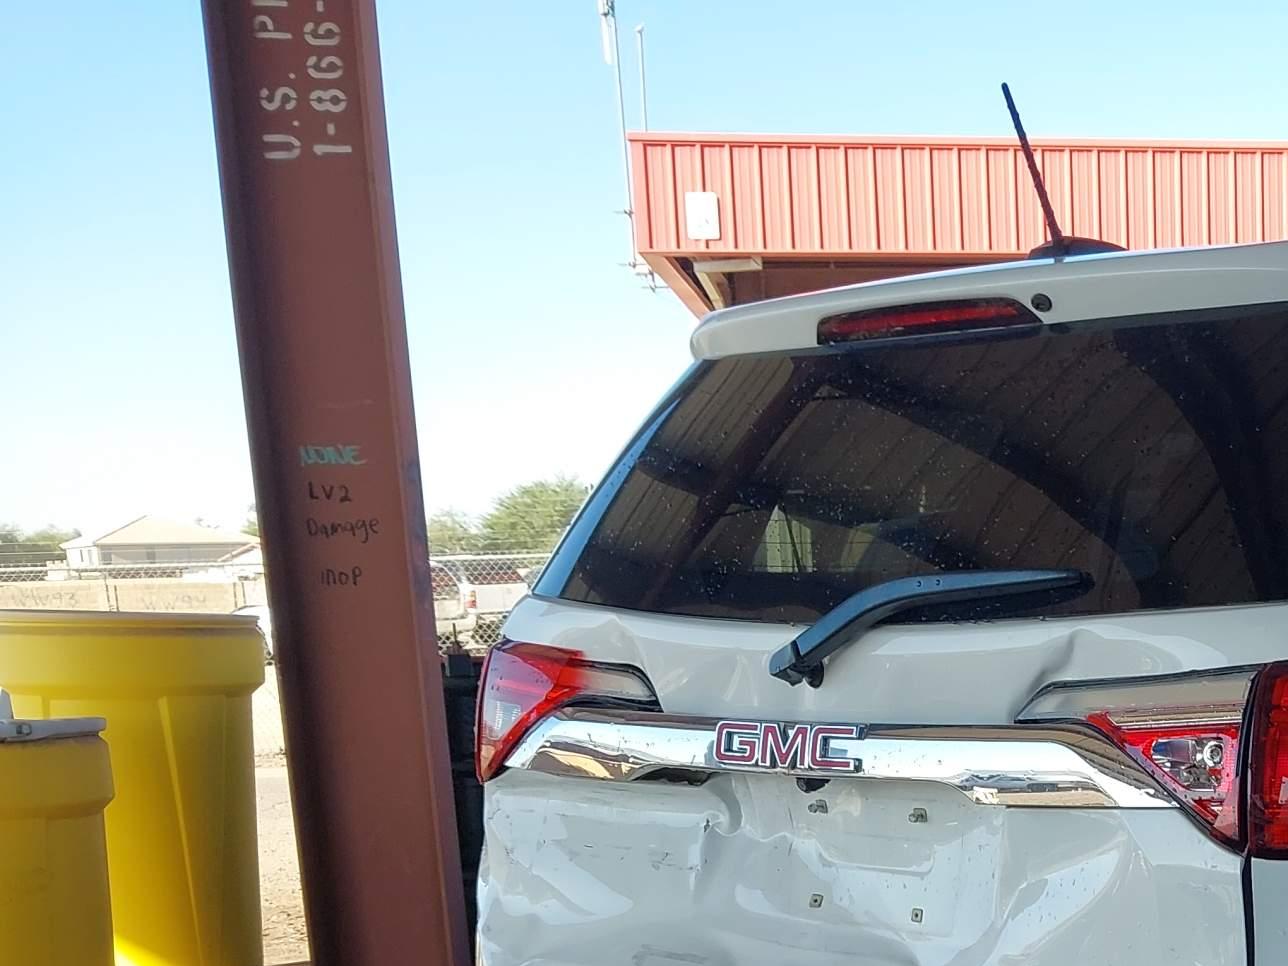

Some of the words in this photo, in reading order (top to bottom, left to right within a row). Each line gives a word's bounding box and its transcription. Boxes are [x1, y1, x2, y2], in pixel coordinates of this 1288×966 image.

[260, 73, 301, 159] U.S.
[306, 517, 380, 544] Damage
[715, 721, 863, 770] GMC
